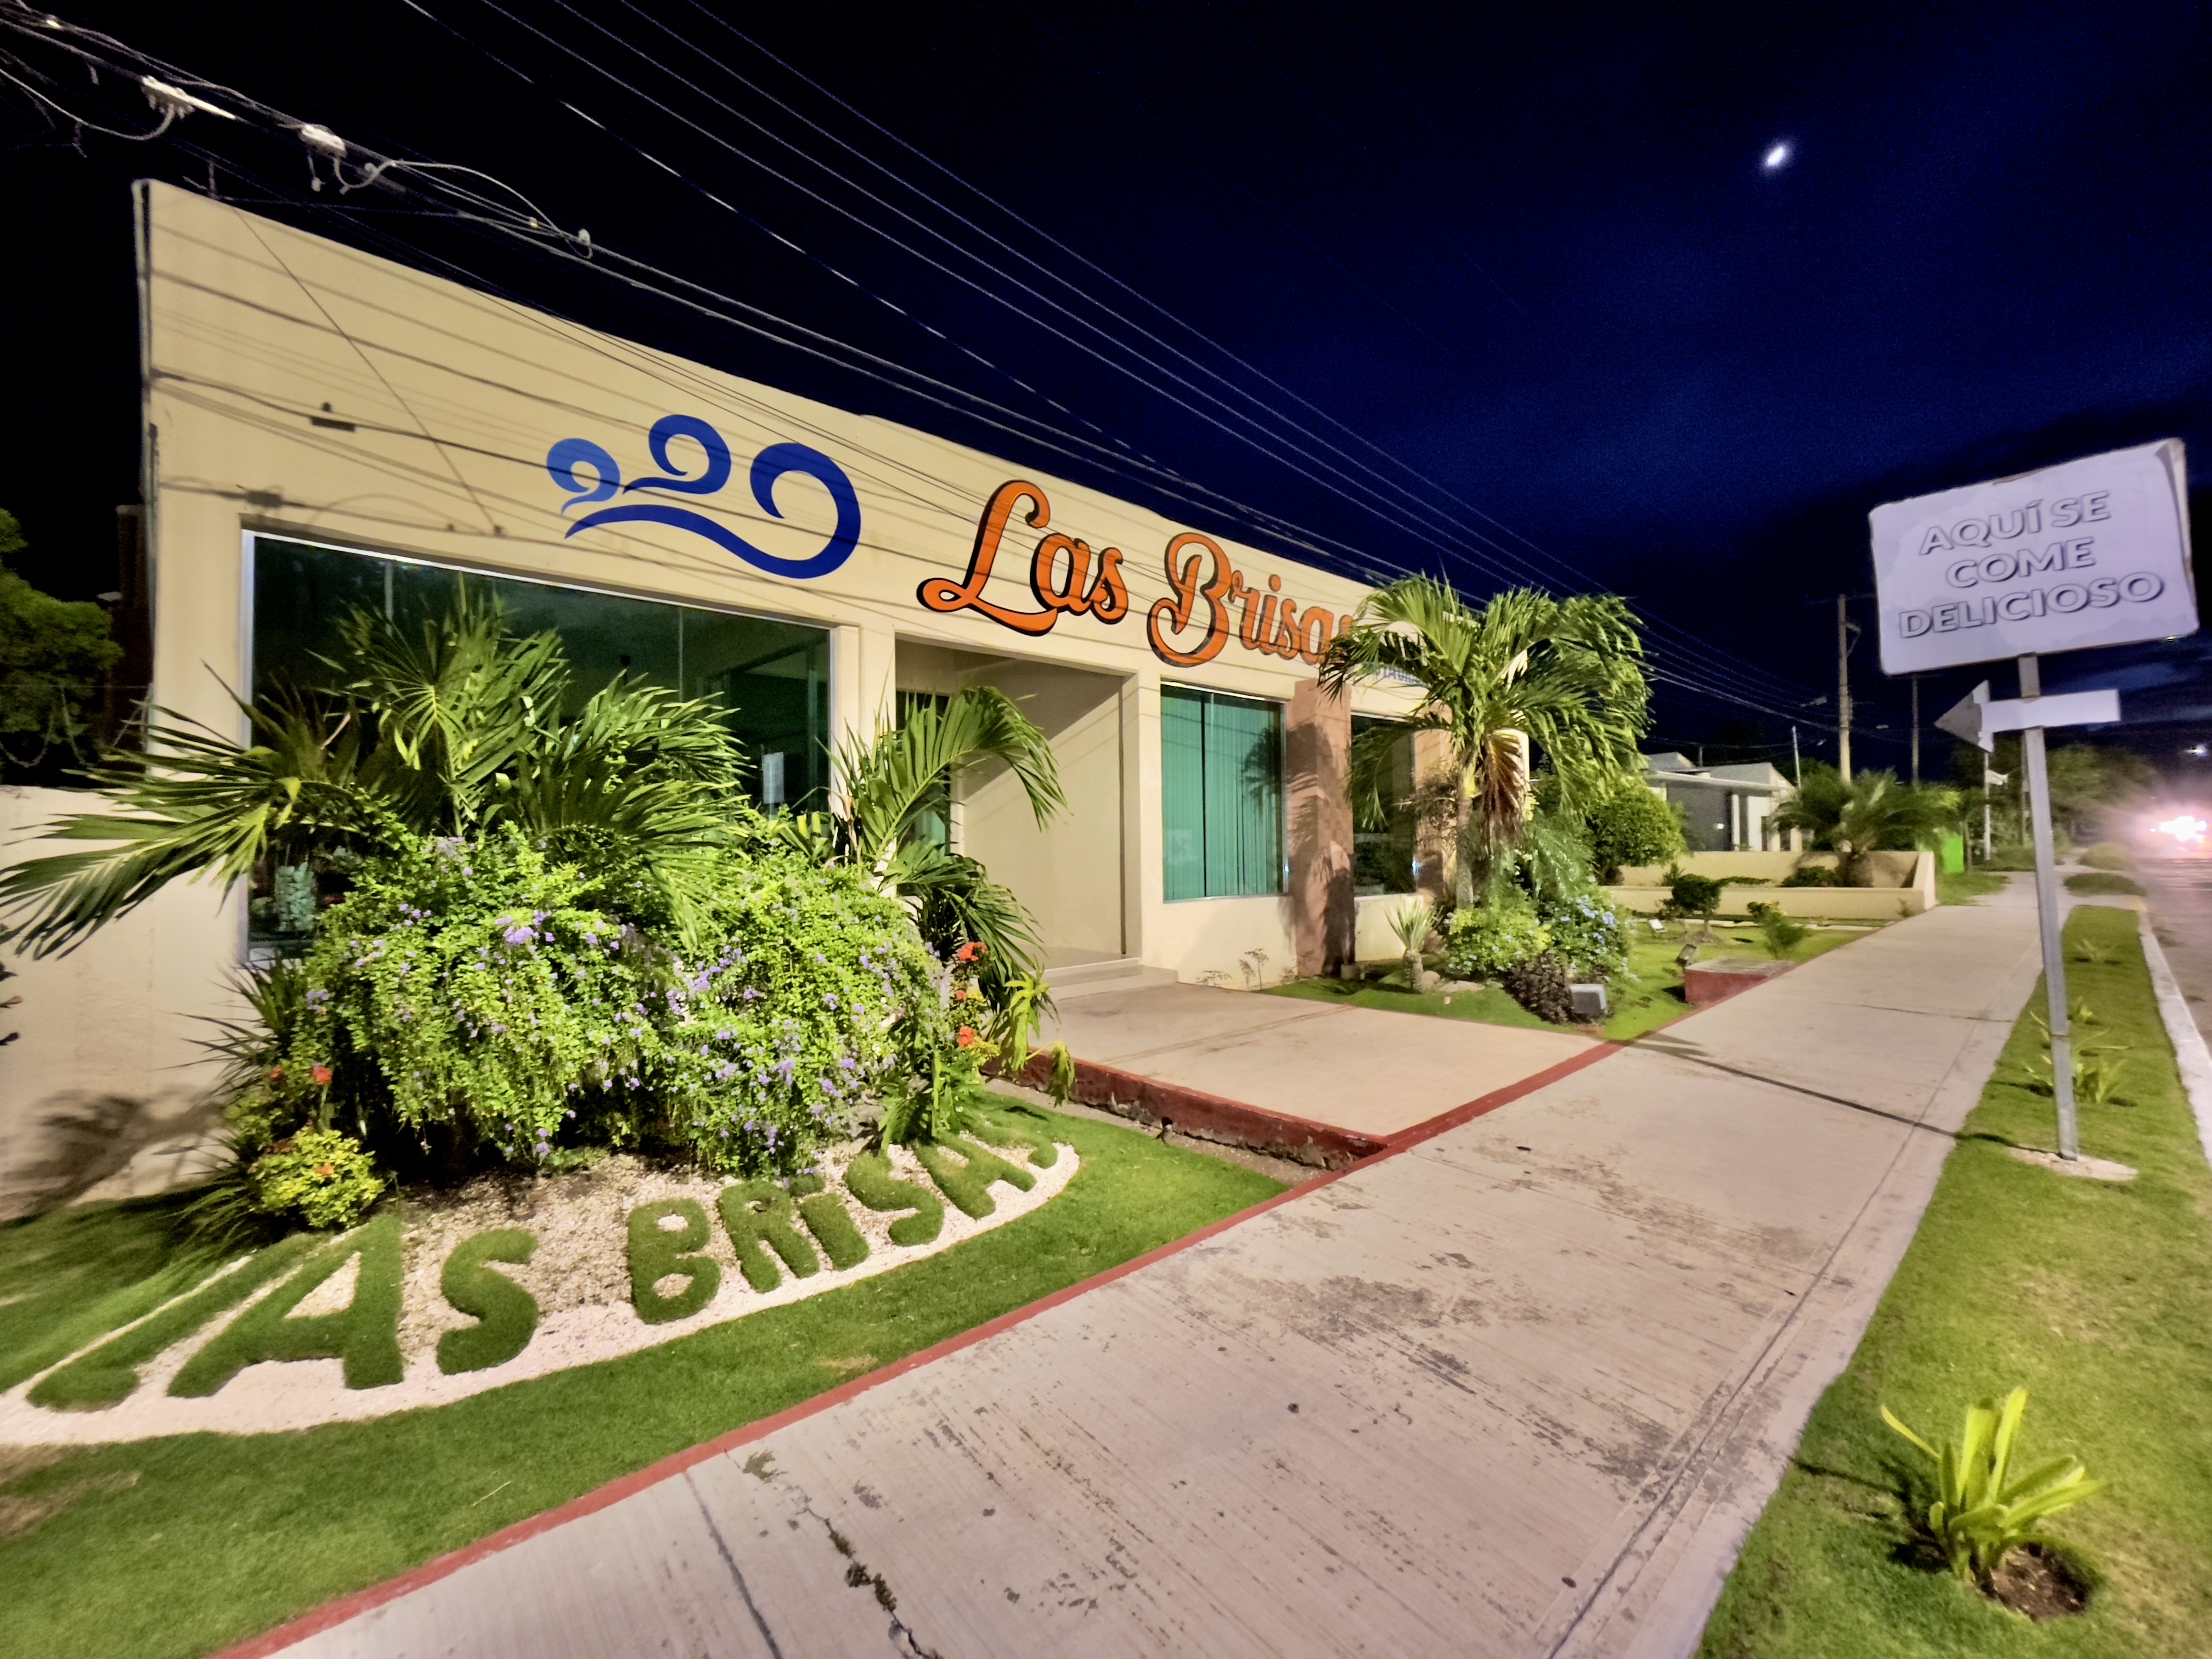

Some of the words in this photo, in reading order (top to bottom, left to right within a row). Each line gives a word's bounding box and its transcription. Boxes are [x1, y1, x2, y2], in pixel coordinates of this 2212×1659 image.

[1918, 499, 2044, 555] AQUÍ
[2051, 490, 2111, 528] SE
[917, 479, 1128, 636] Las
[1946, 537, 2096, 588] COME
[1899, 571, 2164, 638] DELICIOSO
[26, 1213, 539, 1412] LAS
